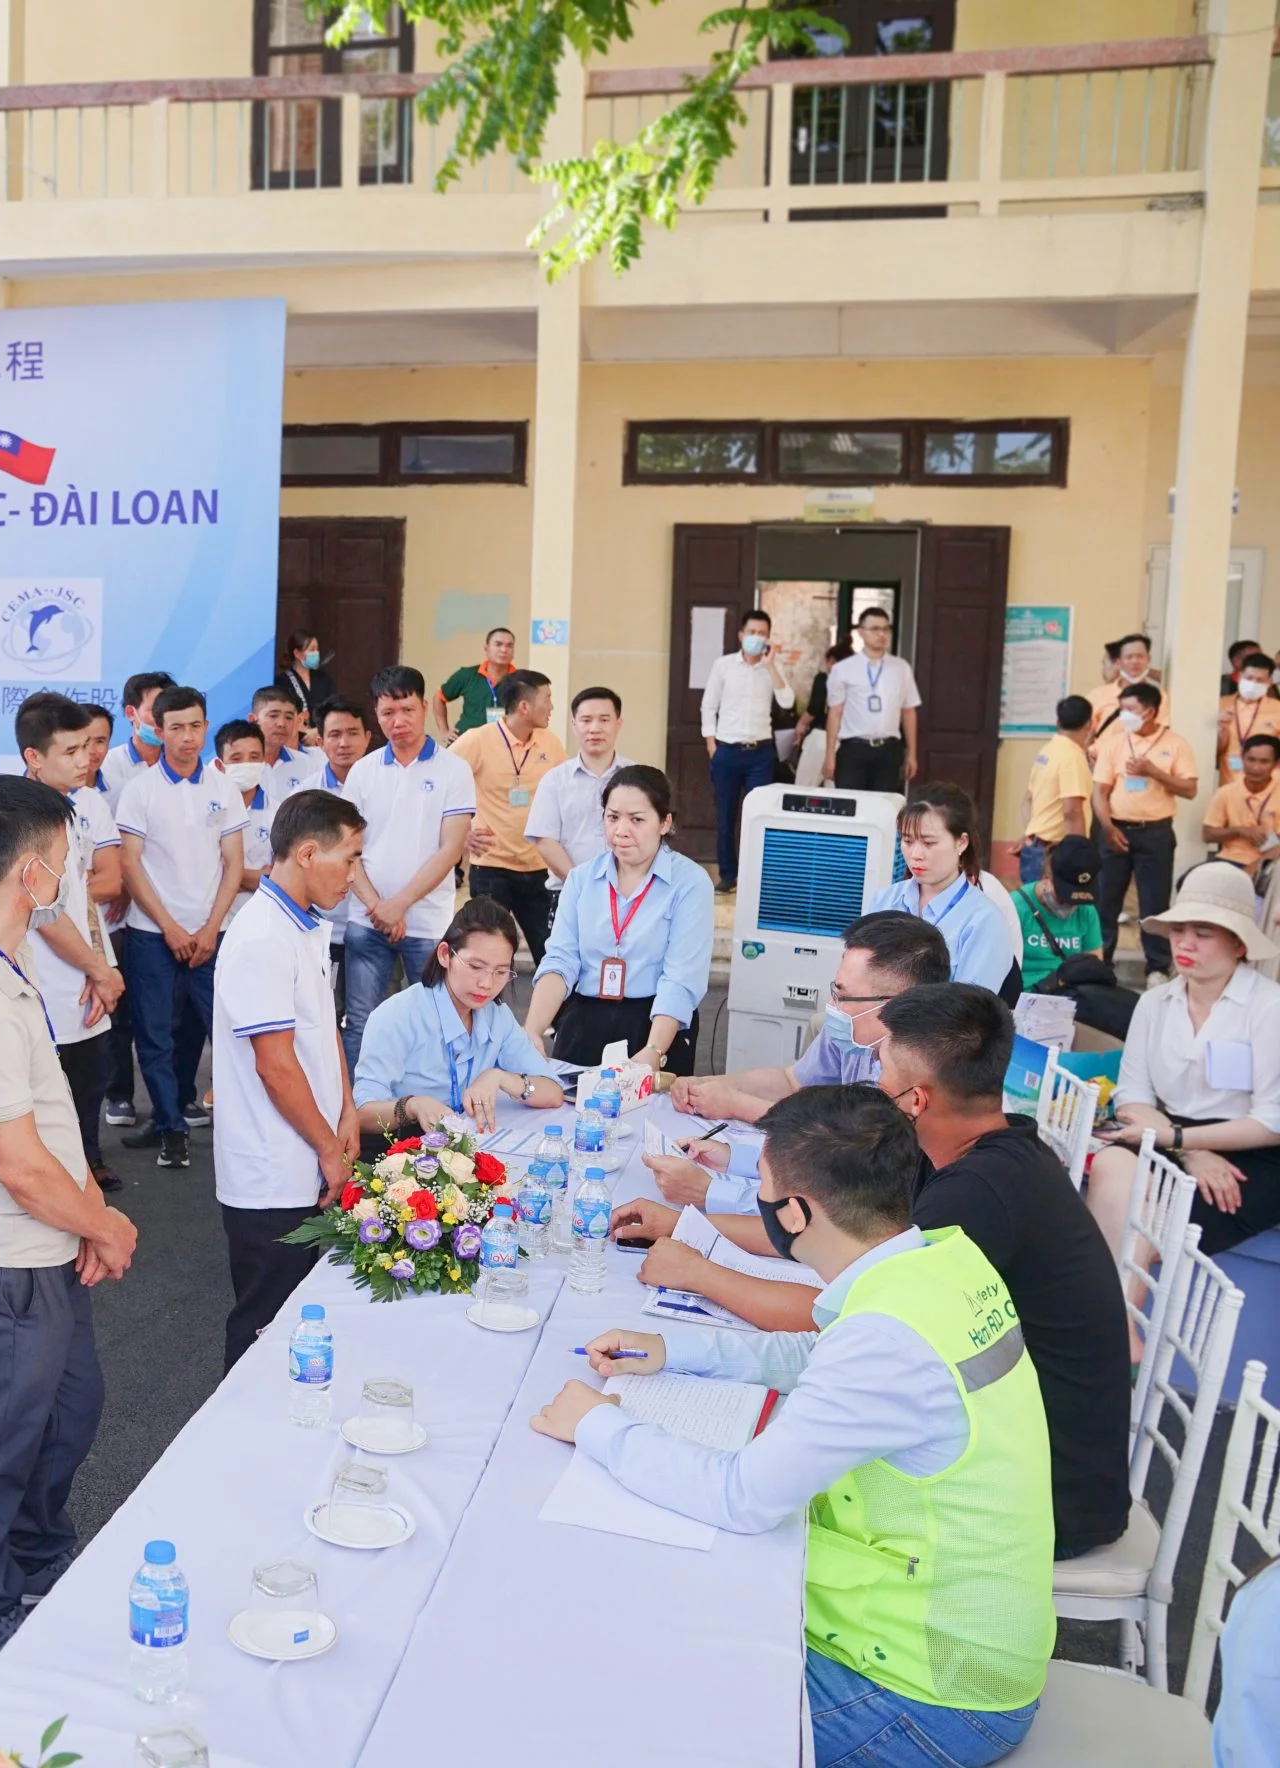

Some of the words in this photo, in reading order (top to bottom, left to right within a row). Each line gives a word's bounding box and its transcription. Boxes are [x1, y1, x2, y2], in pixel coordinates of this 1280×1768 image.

[31, 484, 98, 527] ĐÀI
[111, 489, 219, 526] LOAN
[1027, 933, 1081, 949] CÉNE
